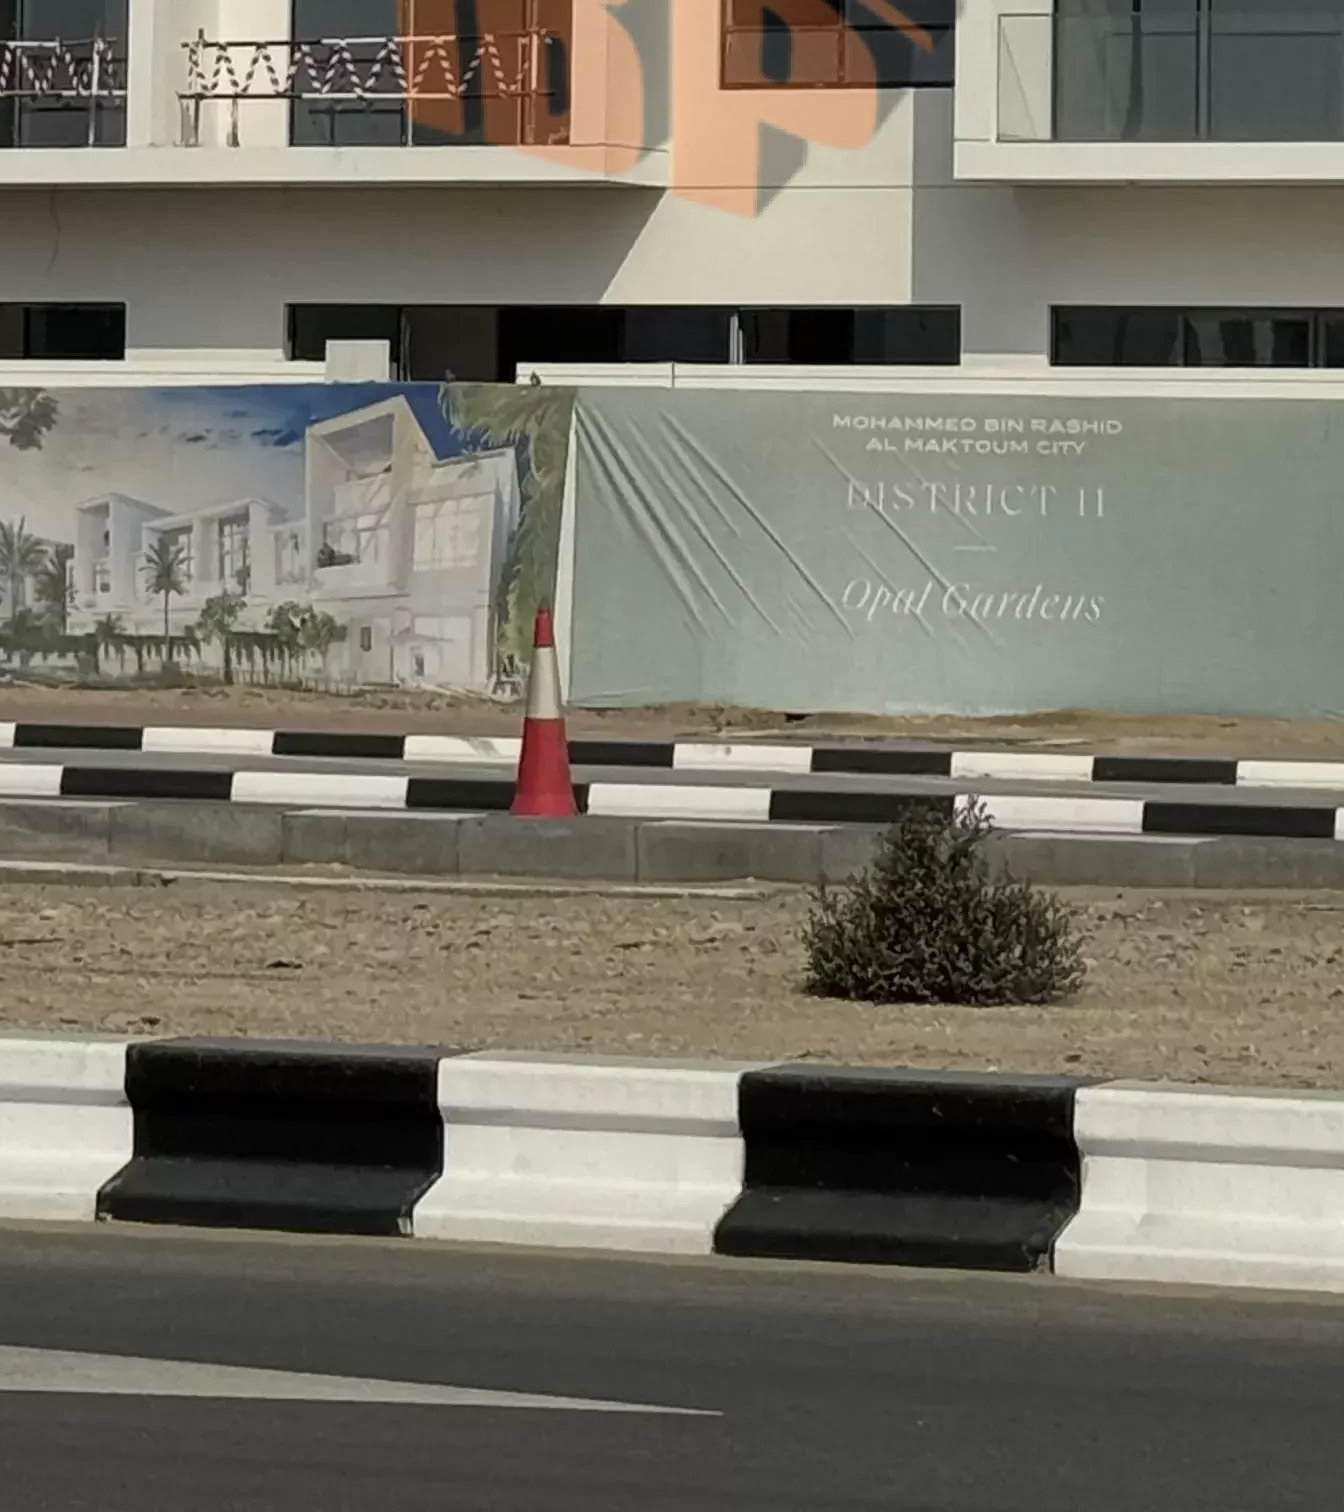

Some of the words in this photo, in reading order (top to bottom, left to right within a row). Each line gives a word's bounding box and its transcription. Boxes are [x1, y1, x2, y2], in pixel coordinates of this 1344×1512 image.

[832, 414, 977, 432] MOHAMMED
[984, 417, 1024, 433] BIN
[1030, 418, 1124, 435] RASHID
[865, 437, 897, 452] AL
[905, 438, 1029, 455] MAKTOUM
[1035, 439, 1087, 456] CITY
[846, 481, 1058, 516] DISTRICT
[841, 577, 934, 623] Opal
[941, 582, 1106, 625] Gardens
